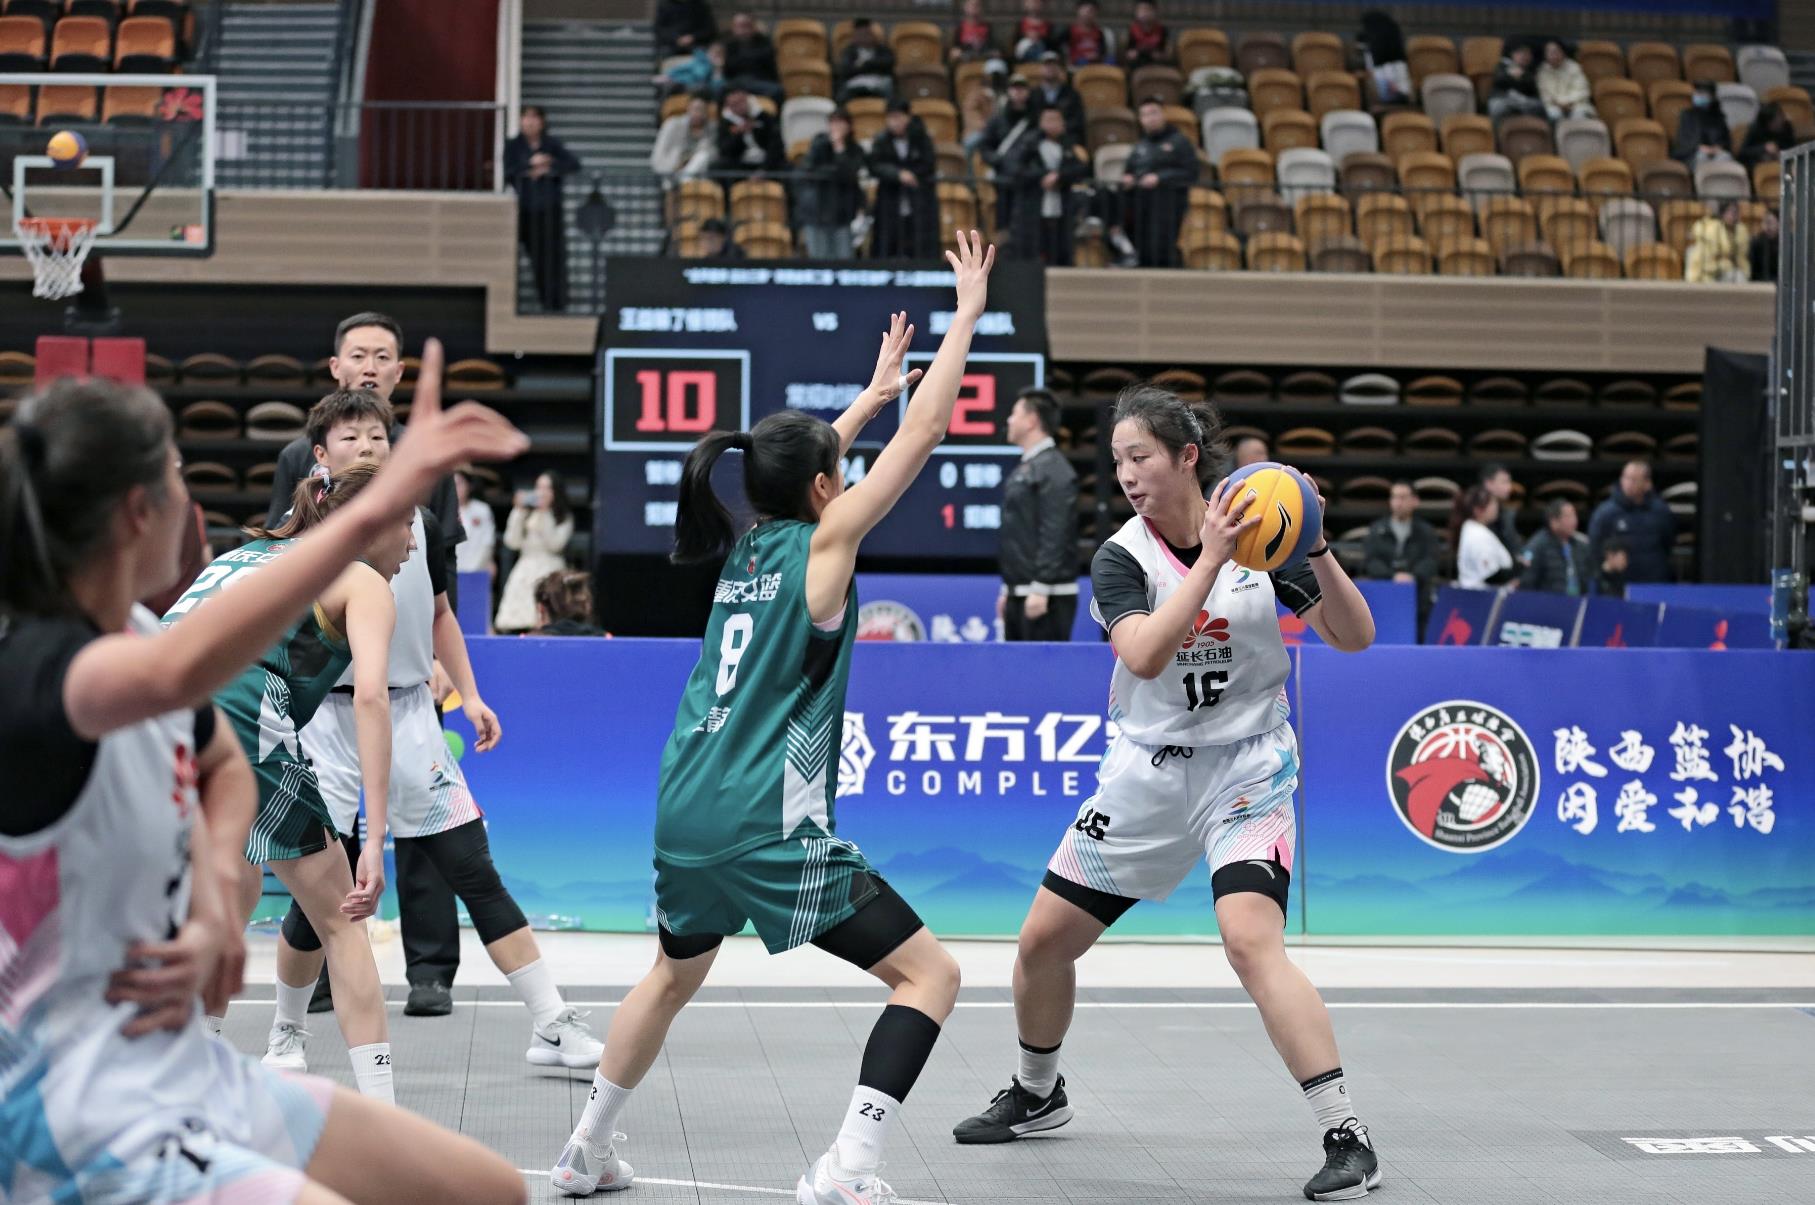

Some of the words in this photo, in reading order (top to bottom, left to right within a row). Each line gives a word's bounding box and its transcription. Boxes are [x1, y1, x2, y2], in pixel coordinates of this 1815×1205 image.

[635, 370, 717, 432] 10
[948, 373, 996, 436] 2
[940, 461, 958, 489] 0
[941, 504, 955, 529] 1
[715, 612, 754, 698] 8
[1176, 646, 1232, 663] 延长石油
[1197, 641, 1215, 649] 1905
[1182, 671, 1229, 712] 16
[887, 711, 1114, 762] 东方亿
[1553, 721, 1785, 783] 陕西篮协
[887, 769, 1103, 796] COMPLE
[1557, 778, 1776, 835] 因爱和谐
[374, 1054, 391, 1066] 23
[859, 1102, 885, 1122] 23
